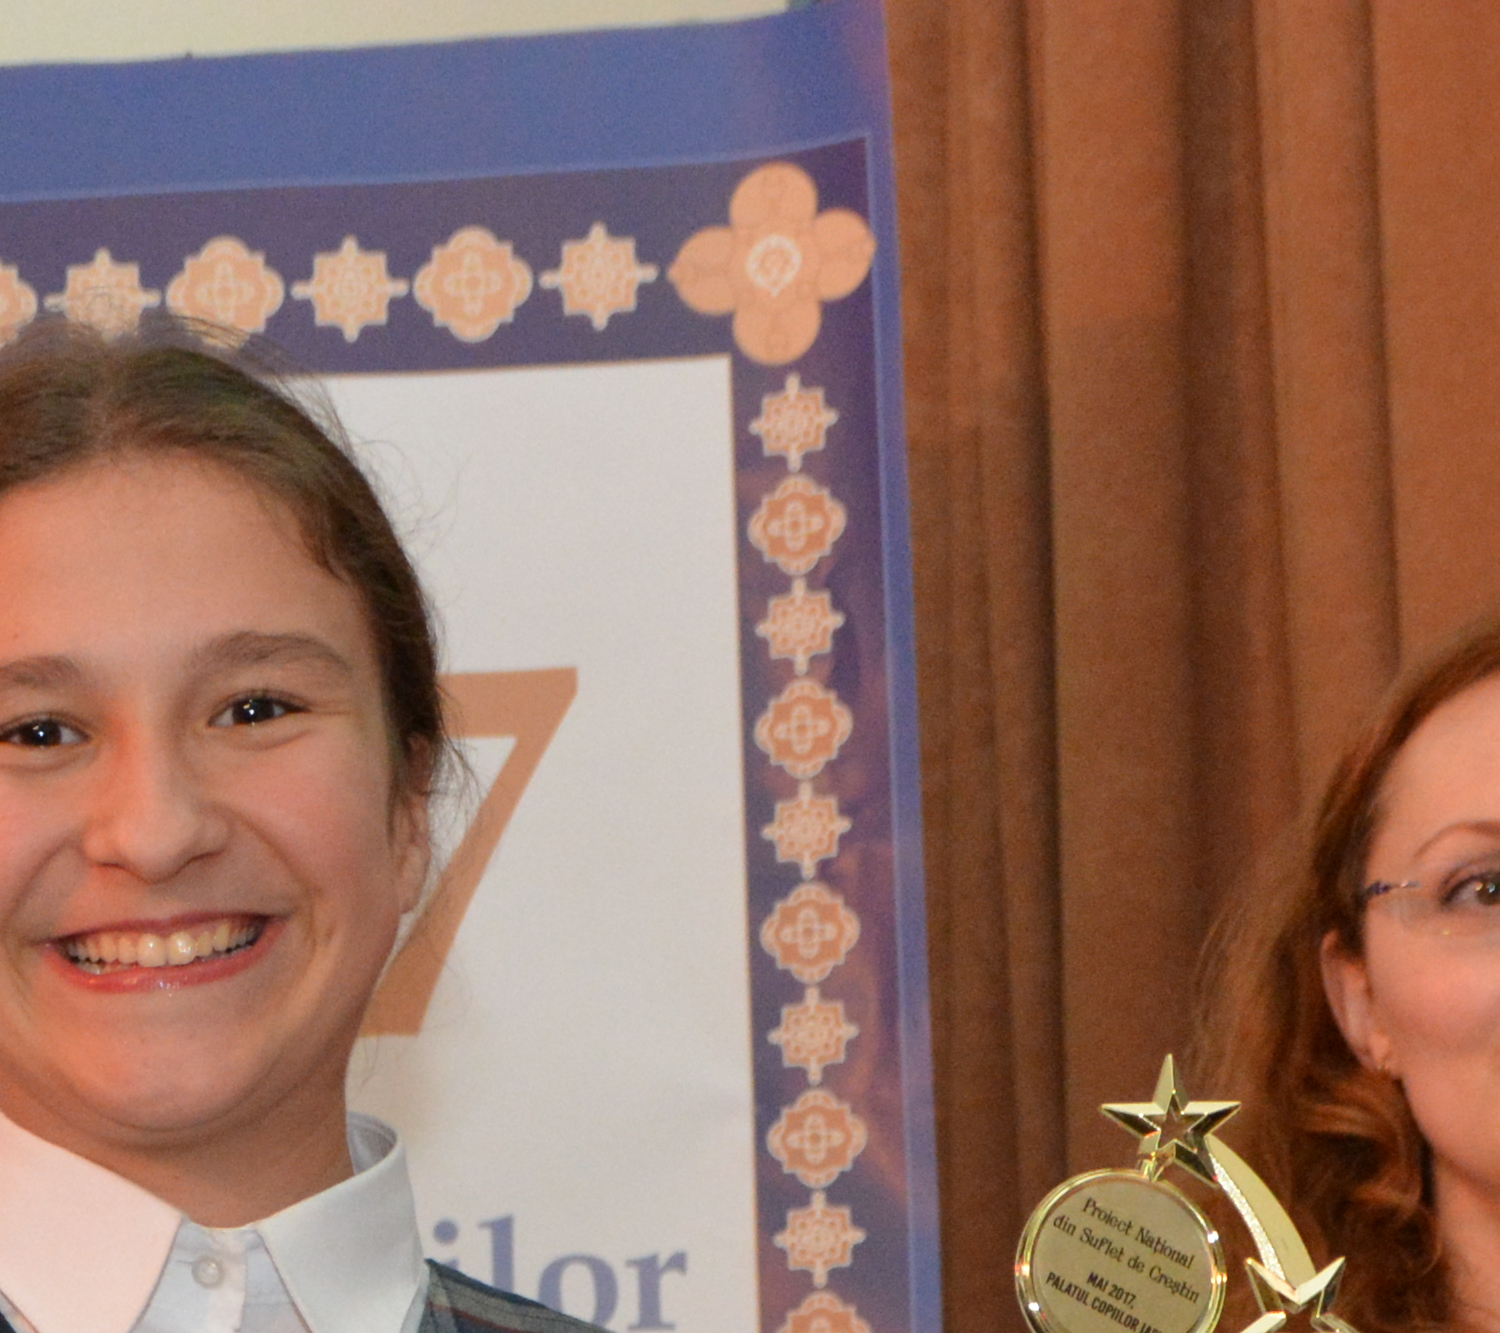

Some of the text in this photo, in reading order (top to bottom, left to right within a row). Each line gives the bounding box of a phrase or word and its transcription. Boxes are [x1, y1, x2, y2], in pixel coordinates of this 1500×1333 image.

[1052, 1214, 1077, 1237] din
[1079, 1227, 1125, 1263] Suflet
[1127, 1255, 1145, 1274] de
[1045, 1271, 1089, 1307] PALATUL
[1086, 1270, 1110, 1292] MAI
